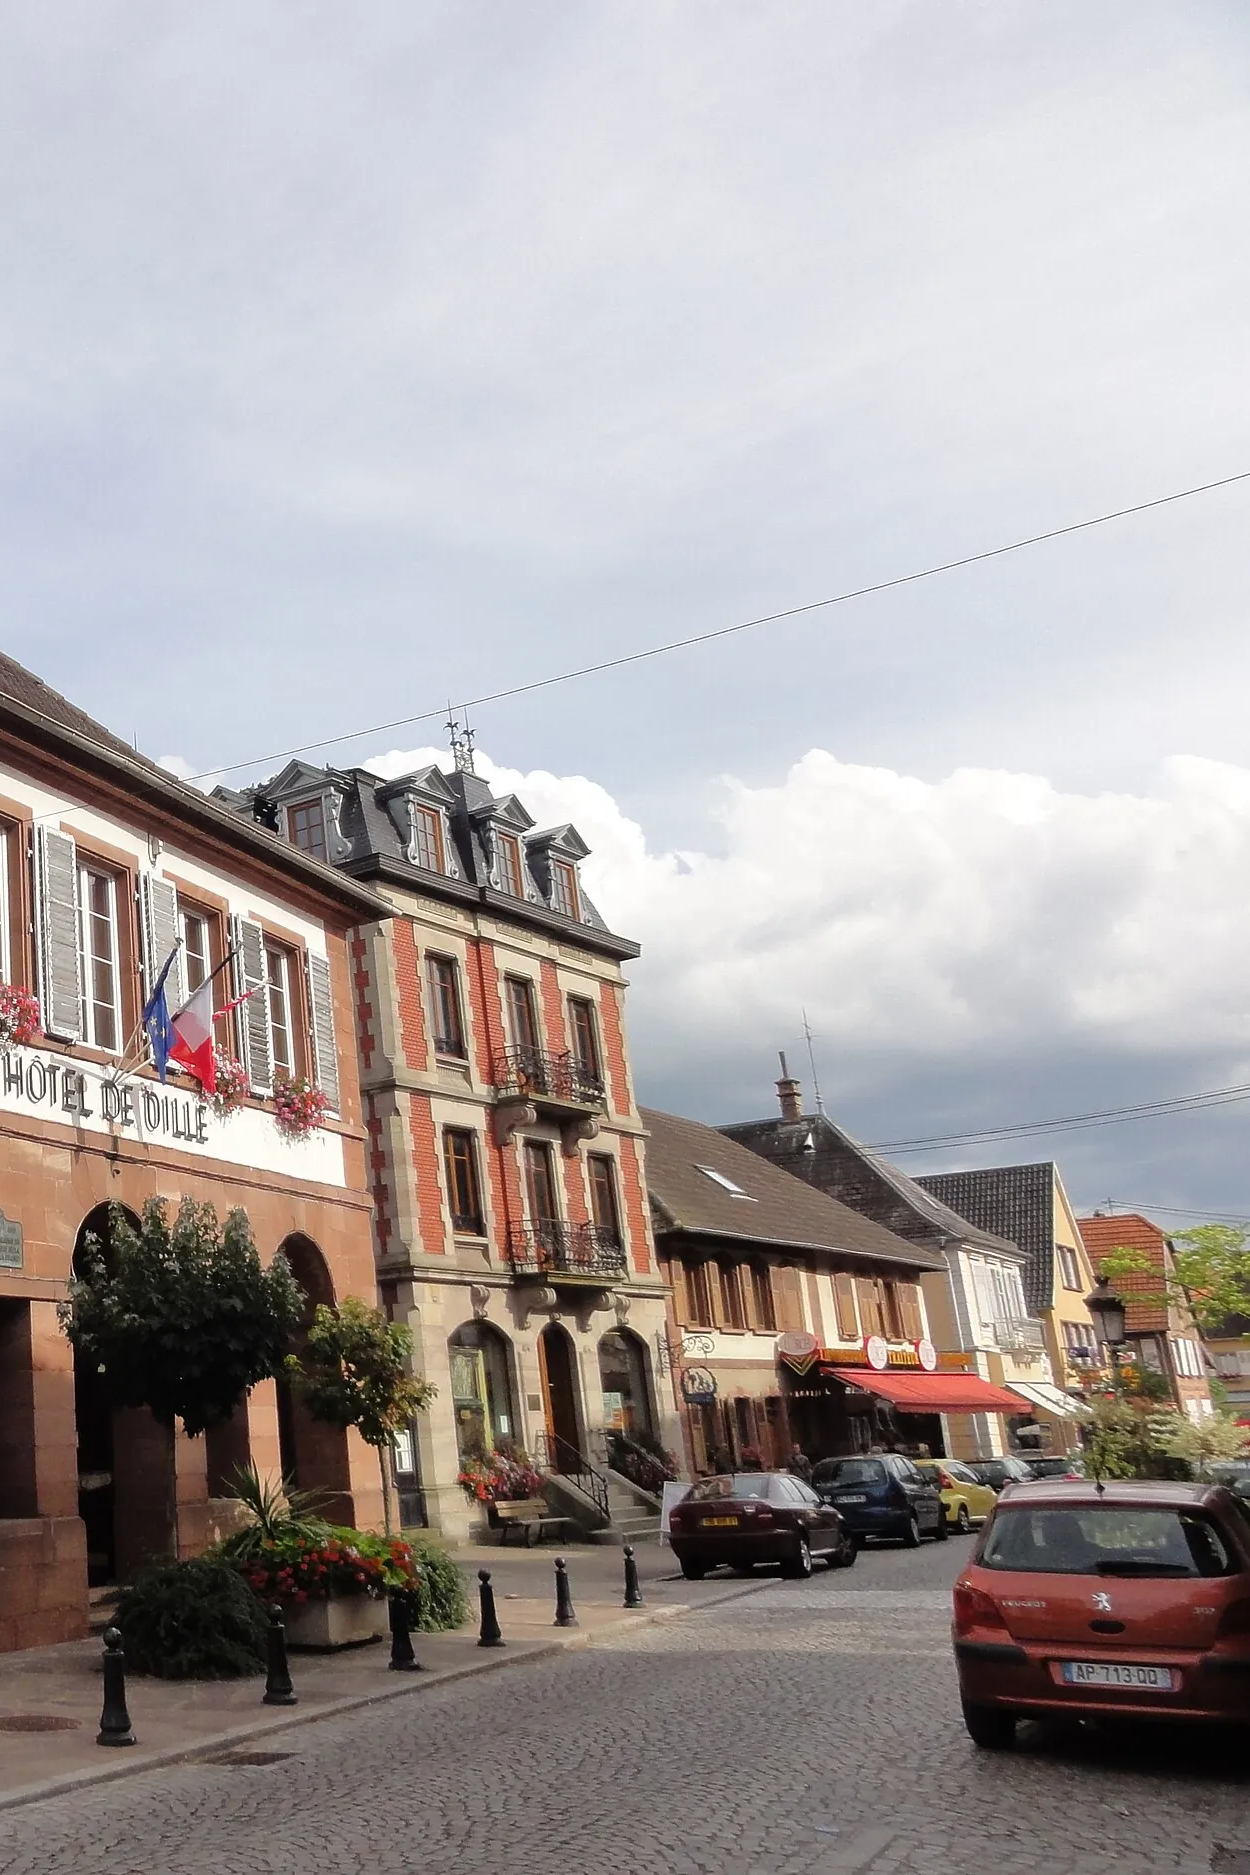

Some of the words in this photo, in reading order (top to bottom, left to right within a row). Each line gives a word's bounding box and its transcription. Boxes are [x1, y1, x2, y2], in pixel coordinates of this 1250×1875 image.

[2, 1052, 93, 1117] HÔTEL
[100, 1079, 134, 1127] DE
[141, 1085, 209, 1144] VILLE
[1001, 1600, 1047, 1608] PEUGEOT
